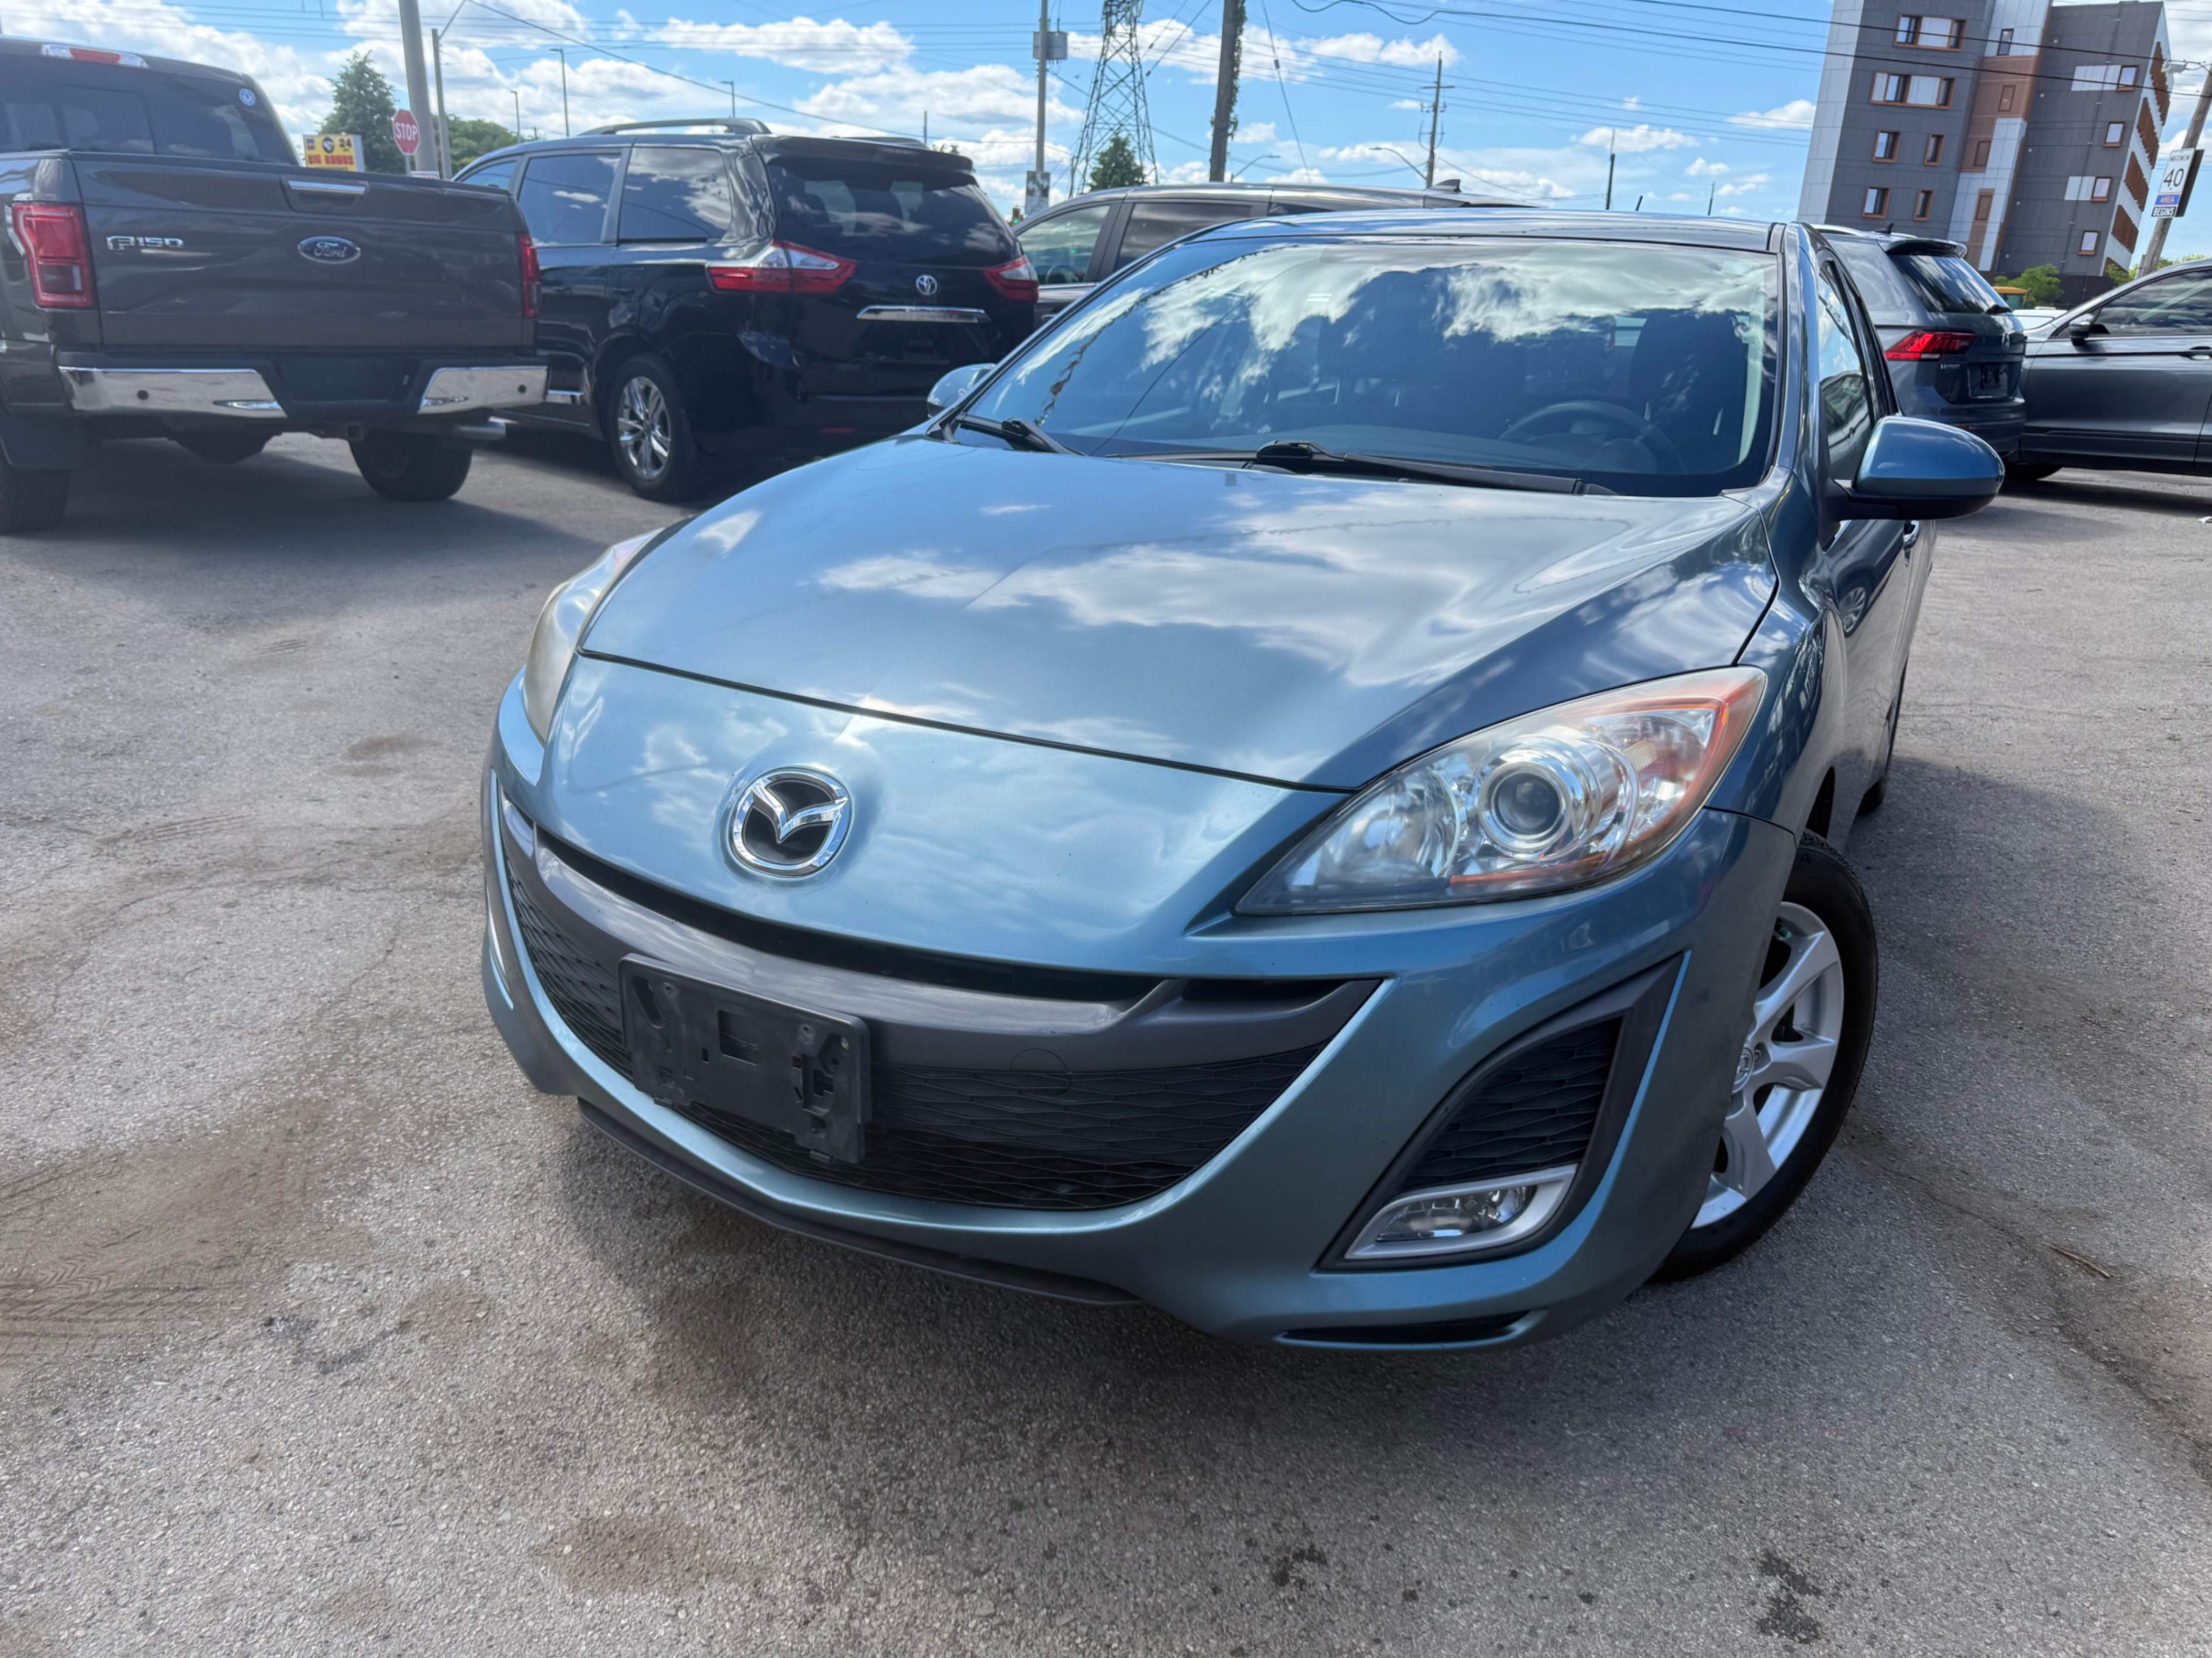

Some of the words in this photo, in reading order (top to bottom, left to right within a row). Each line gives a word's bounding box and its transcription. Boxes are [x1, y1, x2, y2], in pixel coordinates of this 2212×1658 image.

[395, 122, 418, 141] STOP
[2163, 168, 2185, 188] 40
[2152, 206, 2175, 217] BEGINS
[314, 241, 348, 258] Ford
